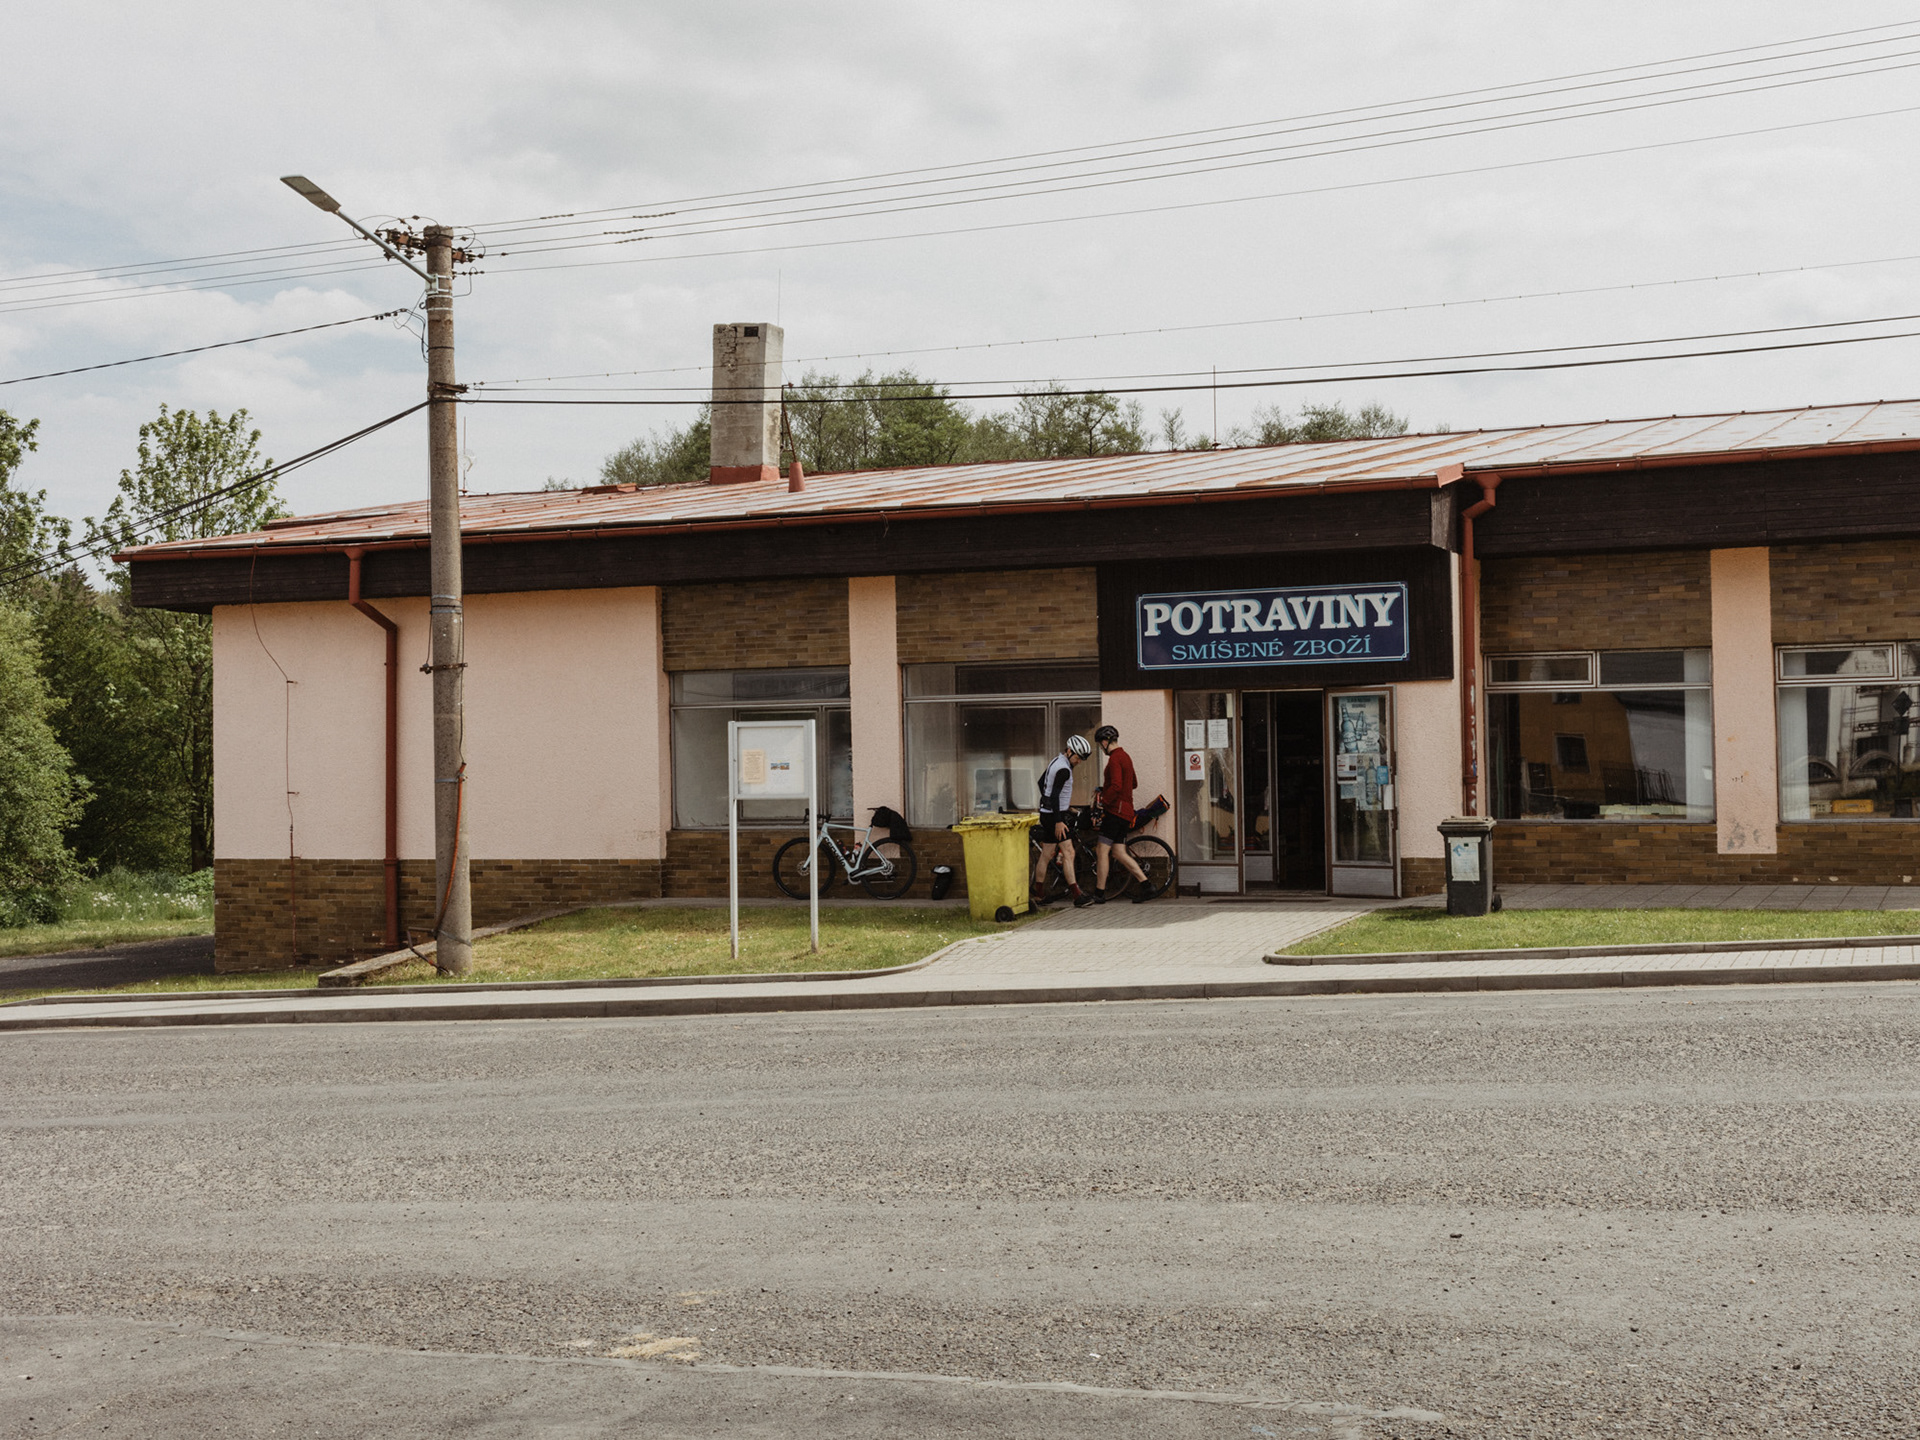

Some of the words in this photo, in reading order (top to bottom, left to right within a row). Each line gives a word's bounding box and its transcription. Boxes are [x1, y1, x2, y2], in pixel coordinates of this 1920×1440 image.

[1143, 592, 1400, 636] POTRAVINY
[1172, 639, 1284, 660] SMÍŠENÉ
[1293, 634, 1371, 656] ZBOŽÍ
